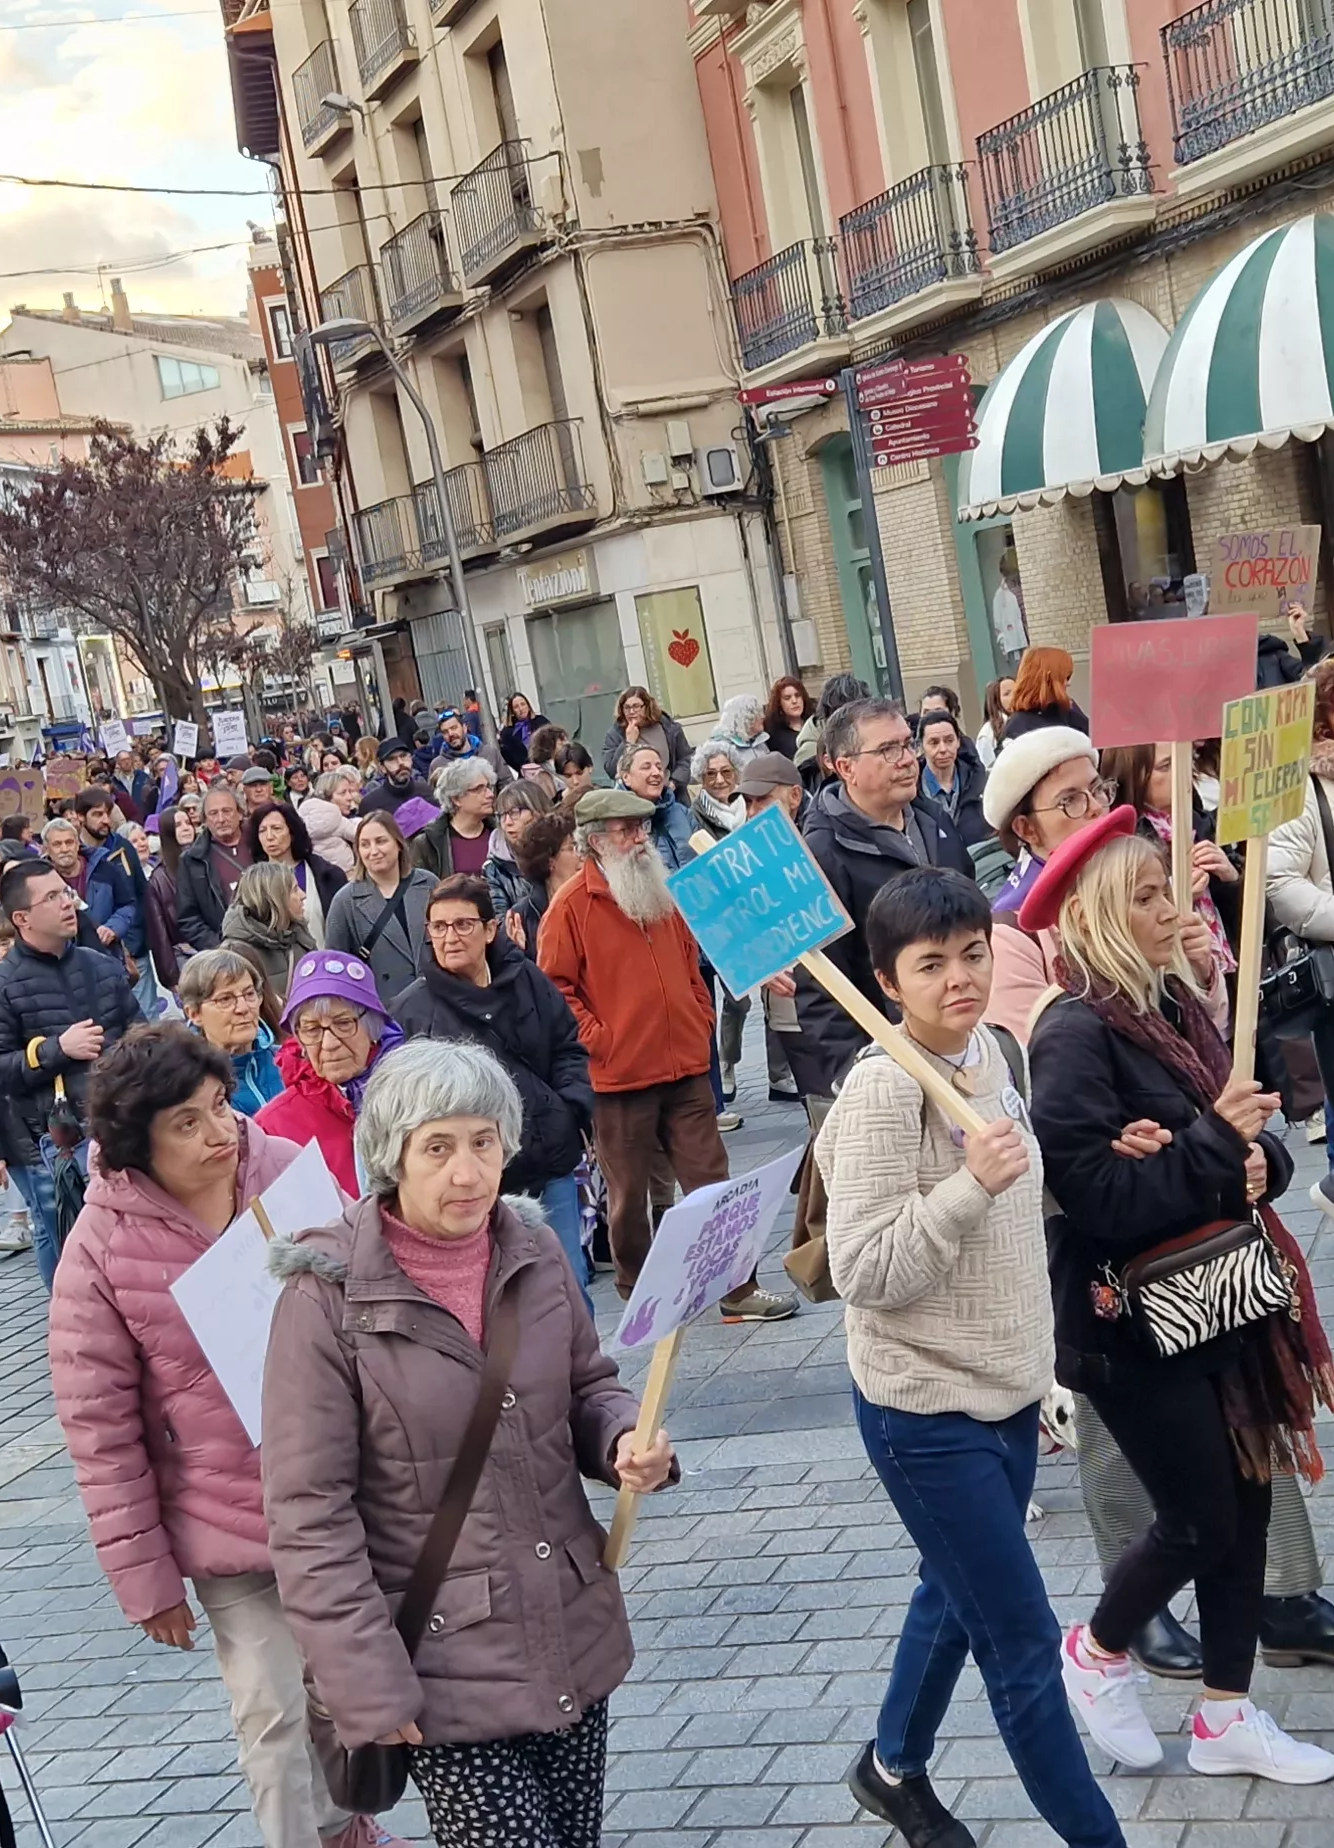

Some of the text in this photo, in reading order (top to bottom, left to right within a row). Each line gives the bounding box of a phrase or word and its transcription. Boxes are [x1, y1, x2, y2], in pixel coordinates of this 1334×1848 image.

[923, 381, 954, 394] Provincial
[885, 420, 911, 432] Catedral
[890, 451, 911, 461] Centro
[1219, 530, 1298, 561] SOMOS EL
[518, 554, 586, 605] Tentazioni
[1224, 695, 1271, 740] CON
[1243, 730, 1275, 777] SIN
[1252, 756, 1307, 801] CUERPO
[673, 813, 794, 921] CONTRA TU
[683, 1209, 760, 1264] ESTAMOS
[698, 1191, 762, 1241] PORQUE
[686, 1235, 742, 1279] LOCAS
